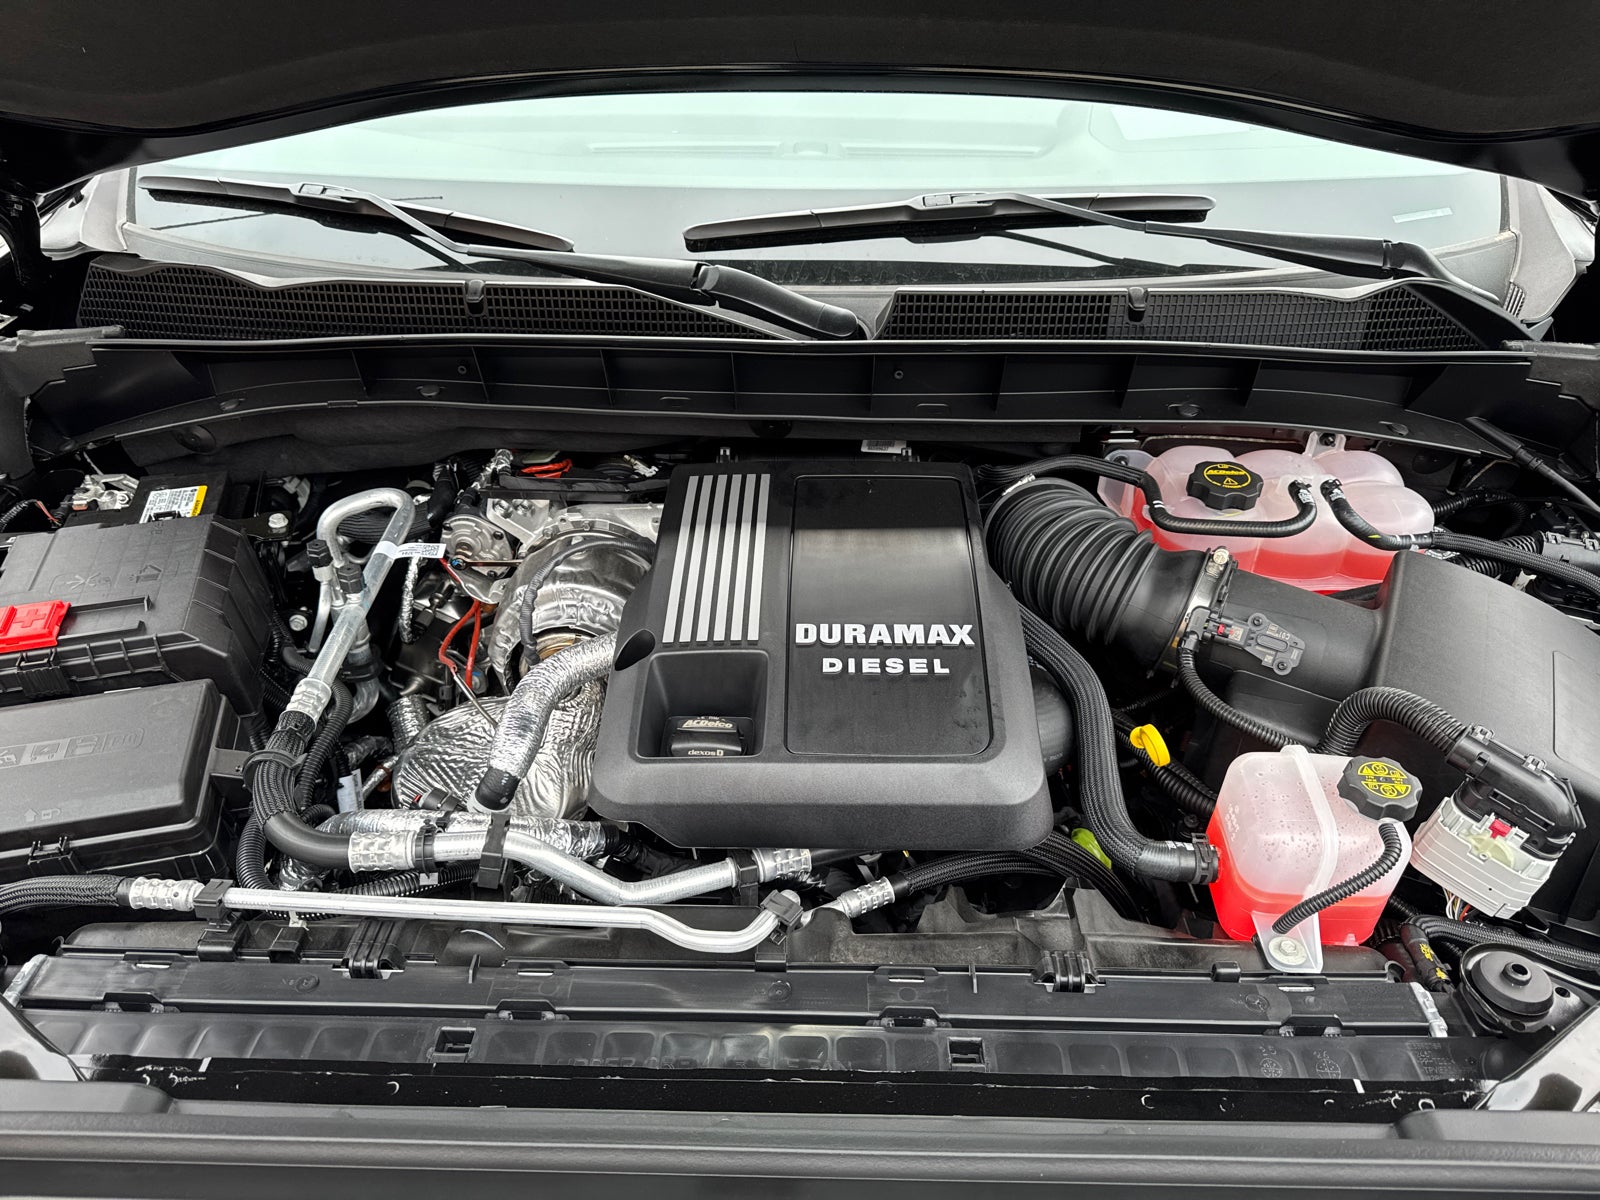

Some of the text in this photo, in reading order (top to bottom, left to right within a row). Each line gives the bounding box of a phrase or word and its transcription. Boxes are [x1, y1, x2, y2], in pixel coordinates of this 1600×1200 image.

[795, 623, 976, 646] DURAMAX
[822, 657, 950, 674] DIESEL
[682, 719, 733, 729] ACDelco
